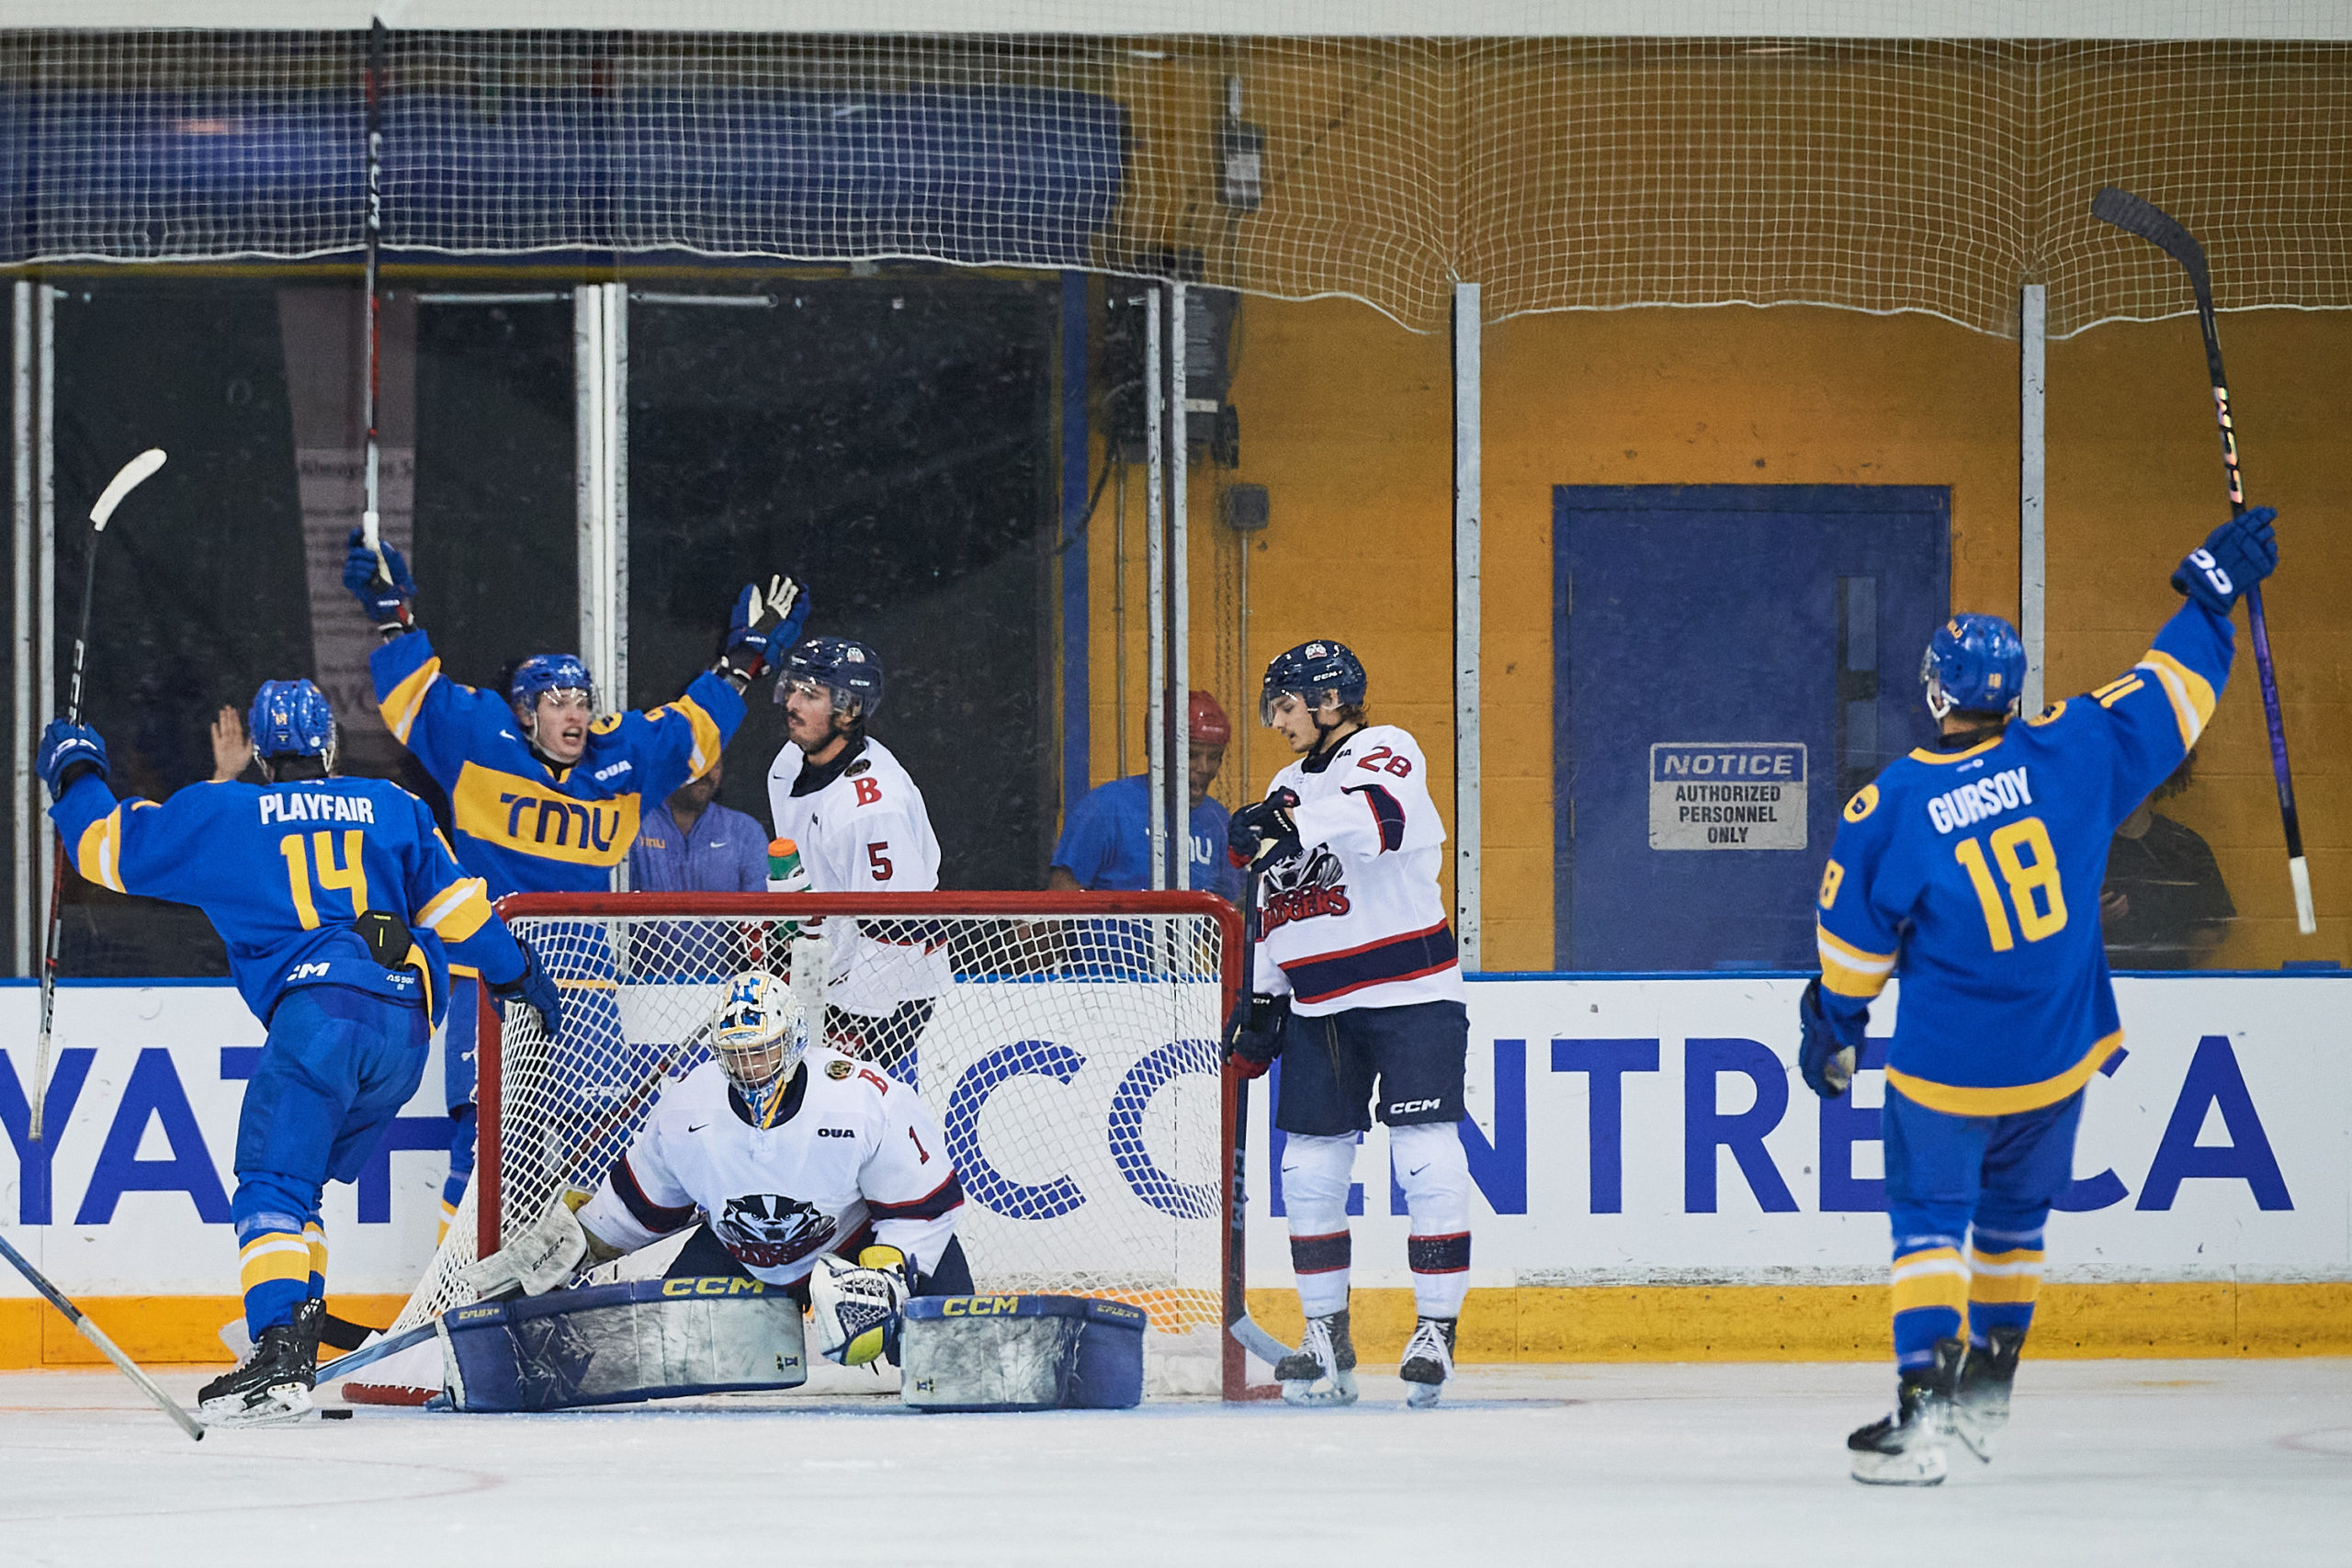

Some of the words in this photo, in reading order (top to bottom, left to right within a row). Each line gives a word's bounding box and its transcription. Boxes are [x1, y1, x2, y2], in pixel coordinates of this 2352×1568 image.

[594, 760, 633, 782] OUA
[1356, 746, 1413, 779] 28
[1664, 754, 1793, 775] NOTICE
[851, 777, 882, 807] B
[1675, 785, 1781, 803] AUTHORIZED
[1927, 766, 2032, 834] GURSOY
[258, 792, 375, 825] PLAYFAIR
[500, 792, 621, 852] TMU
[1679, 806, 1778, 823] PERSONNEL
[1707, 827, 1748, 843] ONLY
[866, 841, 894, 882] 5
[279, 829, 368, 931] 14
[1954, 816, 2069, 953] 18
[857, 1068, 888, 1097] B
[1389, 1097, 1442, 1115] CCM
[817, 1128, 856, 1139] OUA
[905, 1125, 930, 1165] 1
[662, 1277, 765, 1296] CCM
[942, 1297, 1019, 1316] CCM
